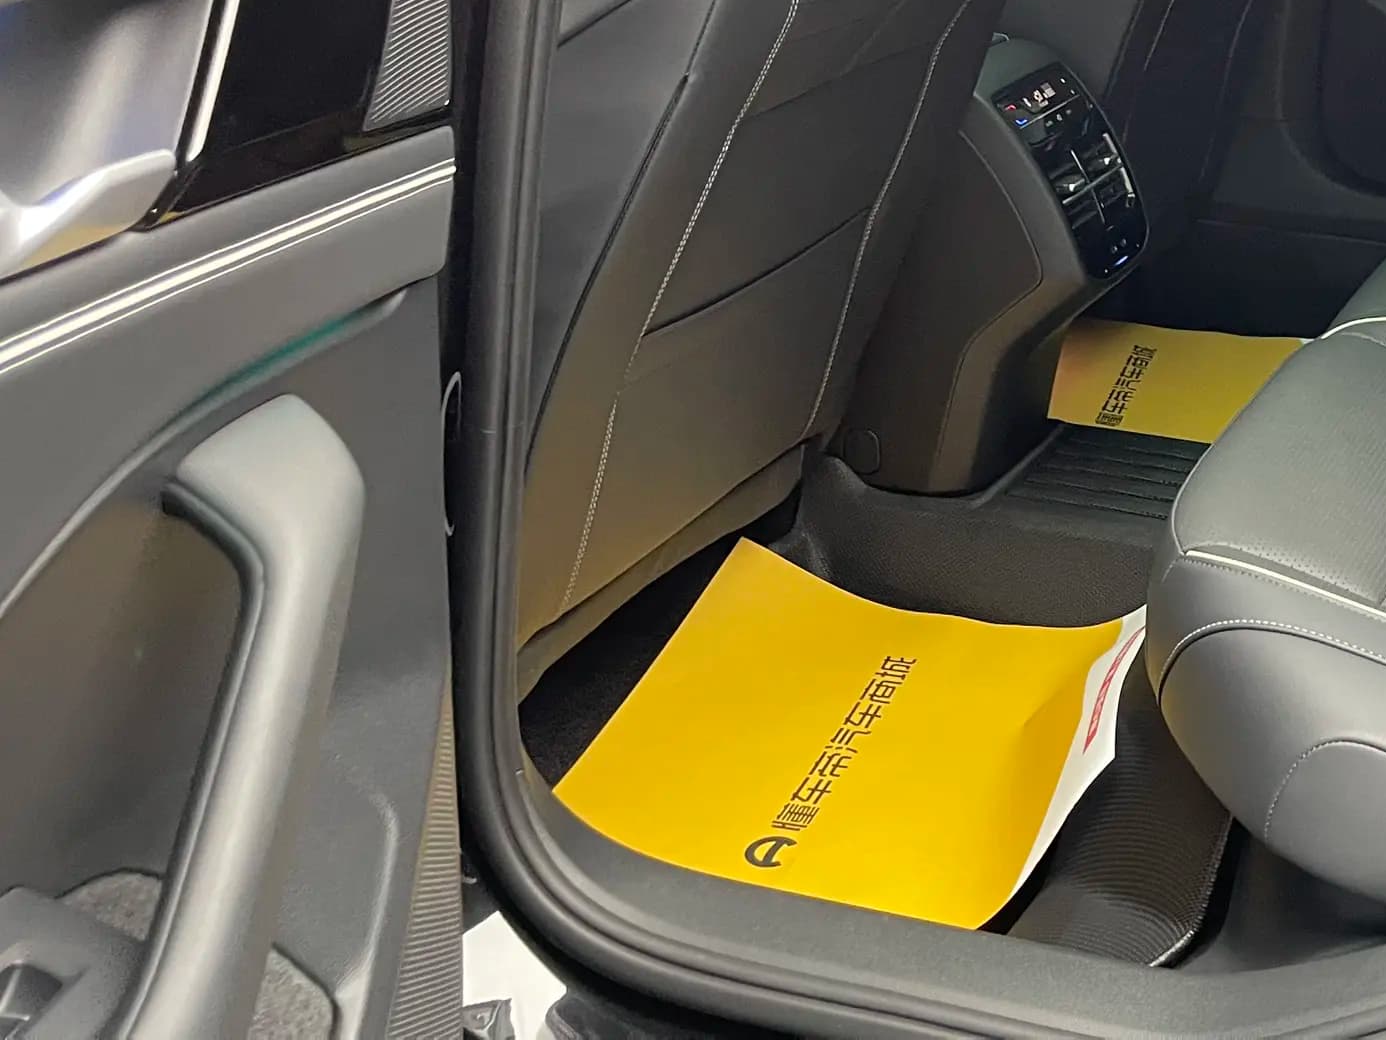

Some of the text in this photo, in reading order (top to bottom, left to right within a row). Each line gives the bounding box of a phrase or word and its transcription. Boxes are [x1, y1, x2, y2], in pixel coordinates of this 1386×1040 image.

[771, 655, 917, 832] 懂车帝汽车商城
